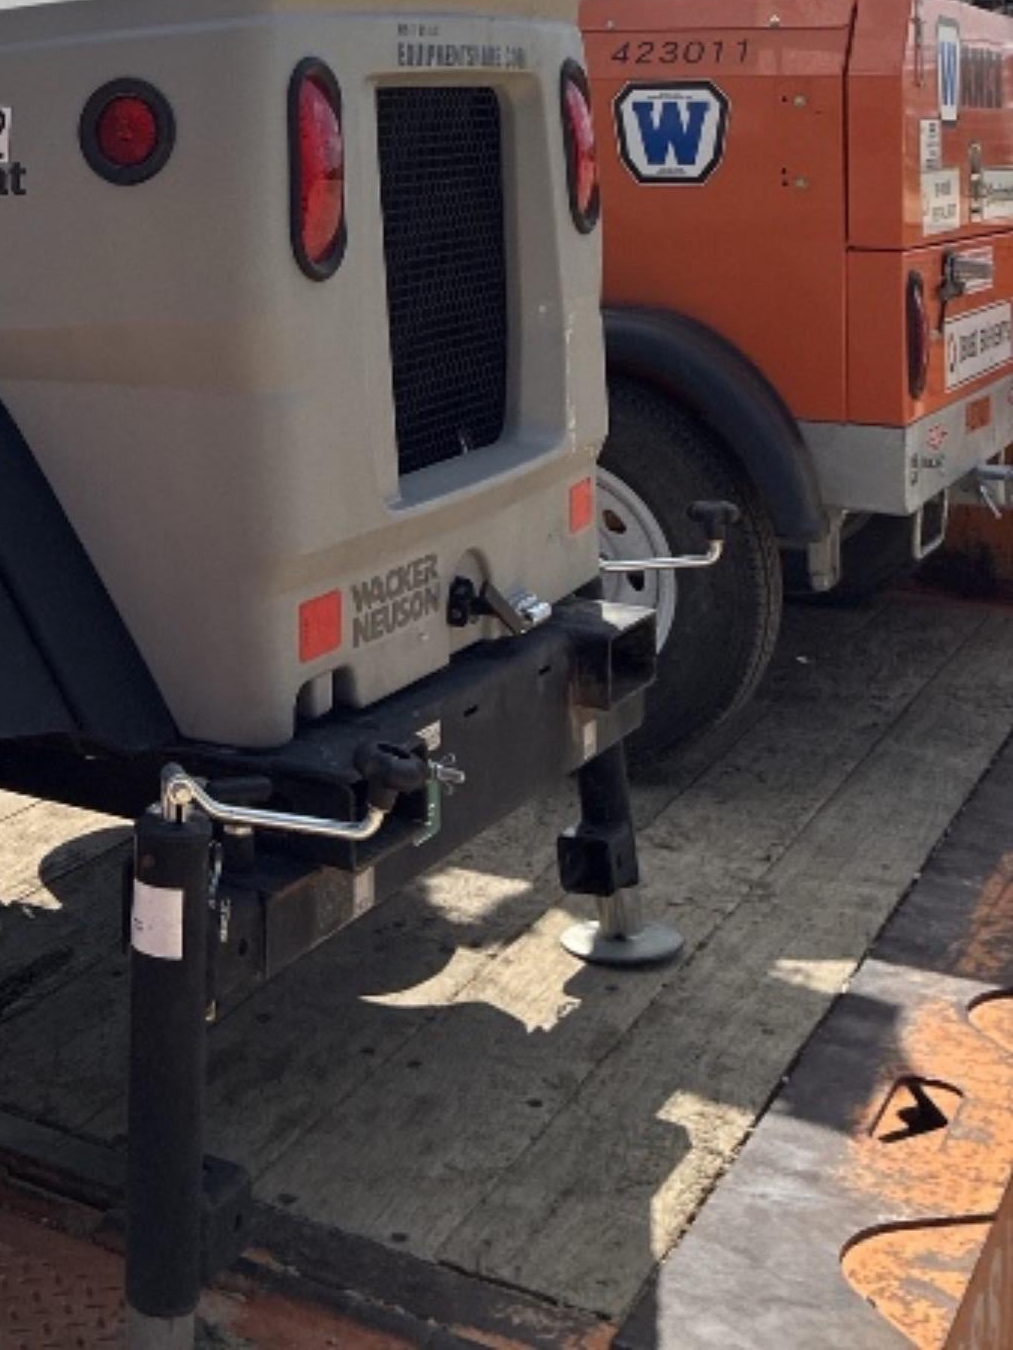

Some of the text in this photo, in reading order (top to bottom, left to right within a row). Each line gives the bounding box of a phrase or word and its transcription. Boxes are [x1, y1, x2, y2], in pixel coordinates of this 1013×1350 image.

[611, 38, 749, 64] 423011
[631, 100, 711, 166] W
[350, 552, 438, 613] WACKER
[352, 584, 443, 649] NEUSON
